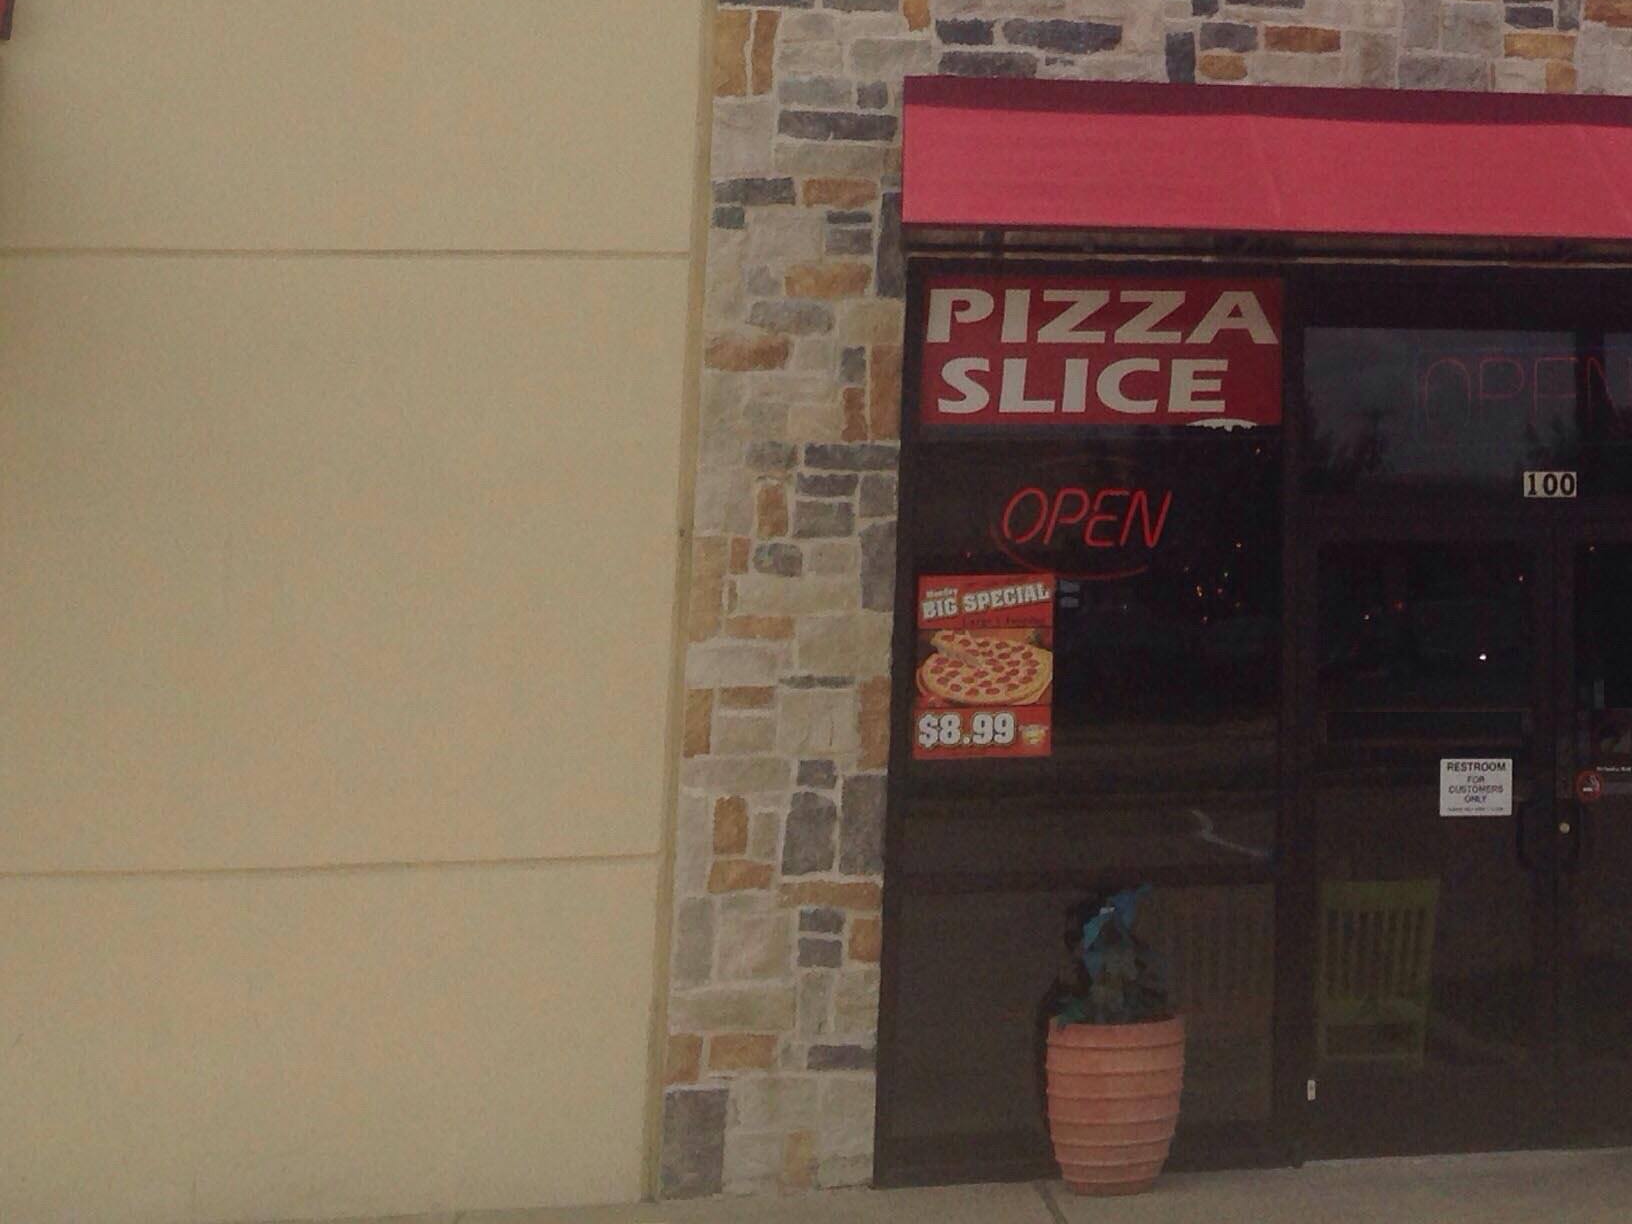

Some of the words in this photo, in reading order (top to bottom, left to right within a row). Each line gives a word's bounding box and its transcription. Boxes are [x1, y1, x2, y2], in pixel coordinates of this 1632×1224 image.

[925, 288, 1280, 345] PIZZA
[937, 357, 1229, 414] SLICE
[1526, 473, 1576, 496] 100
[1002, 487, 1173, 549] OPEN
[922, 598, 959, 619] BIG
[962, 582, 1051, 613] SPECIAL
[917, 712, 1015, 748] $8.99
[1447, 762, 1506, 772] RESTROOM
[1467, 775, 1485, 784] FOR
[1448, 785, 1504, 794] CUSTOMERS
[1464, 794, 1487, 803] ONLY
